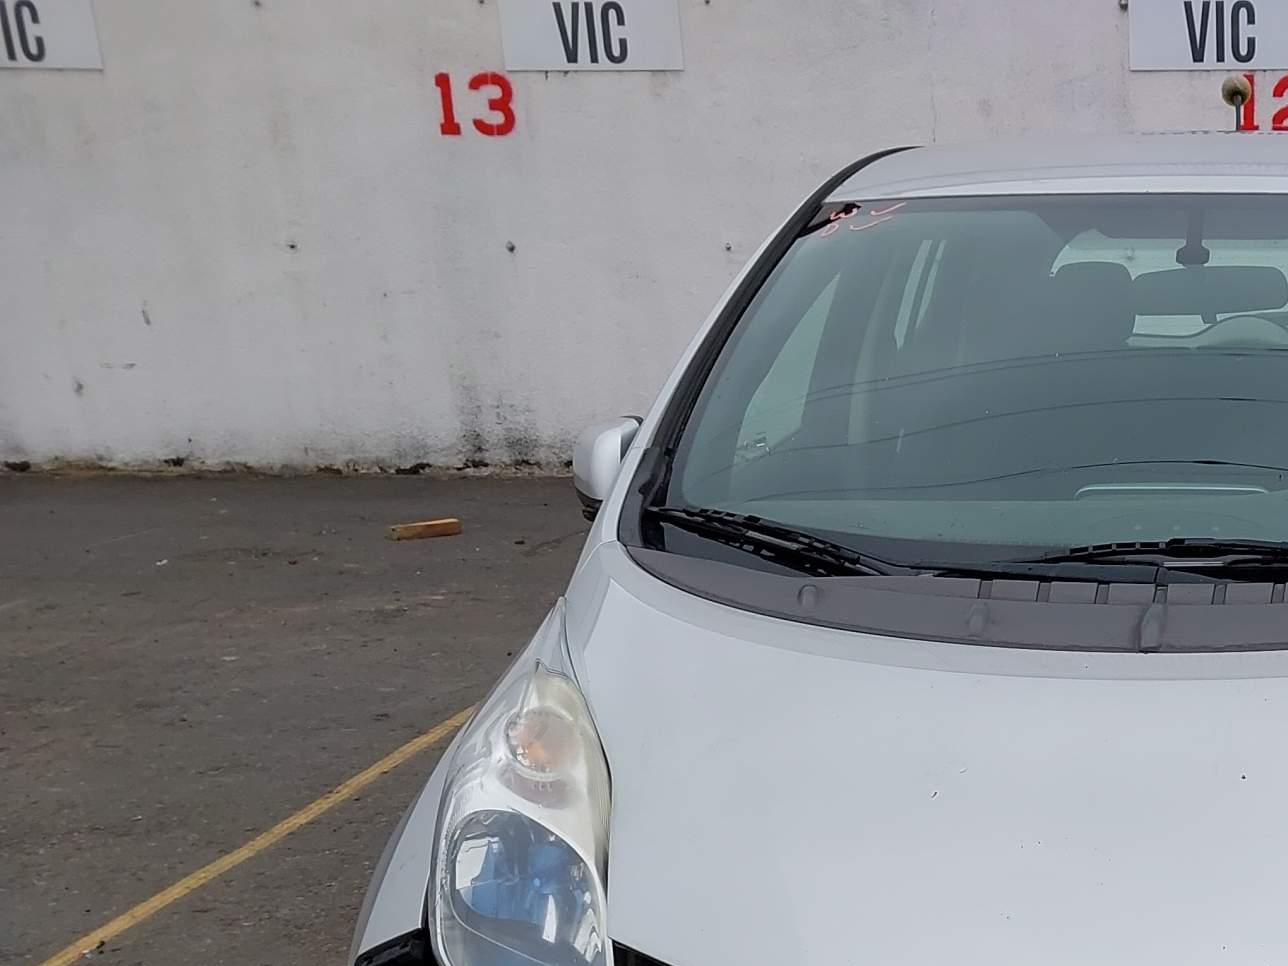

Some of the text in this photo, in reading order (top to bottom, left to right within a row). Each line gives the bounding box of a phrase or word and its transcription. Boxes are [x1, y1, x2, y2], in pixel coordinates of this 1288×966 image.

[552, 1, 628, 64] VIC
[1183, 0, 1257, 64] VIC
[434, 72, 517, 136] 13
